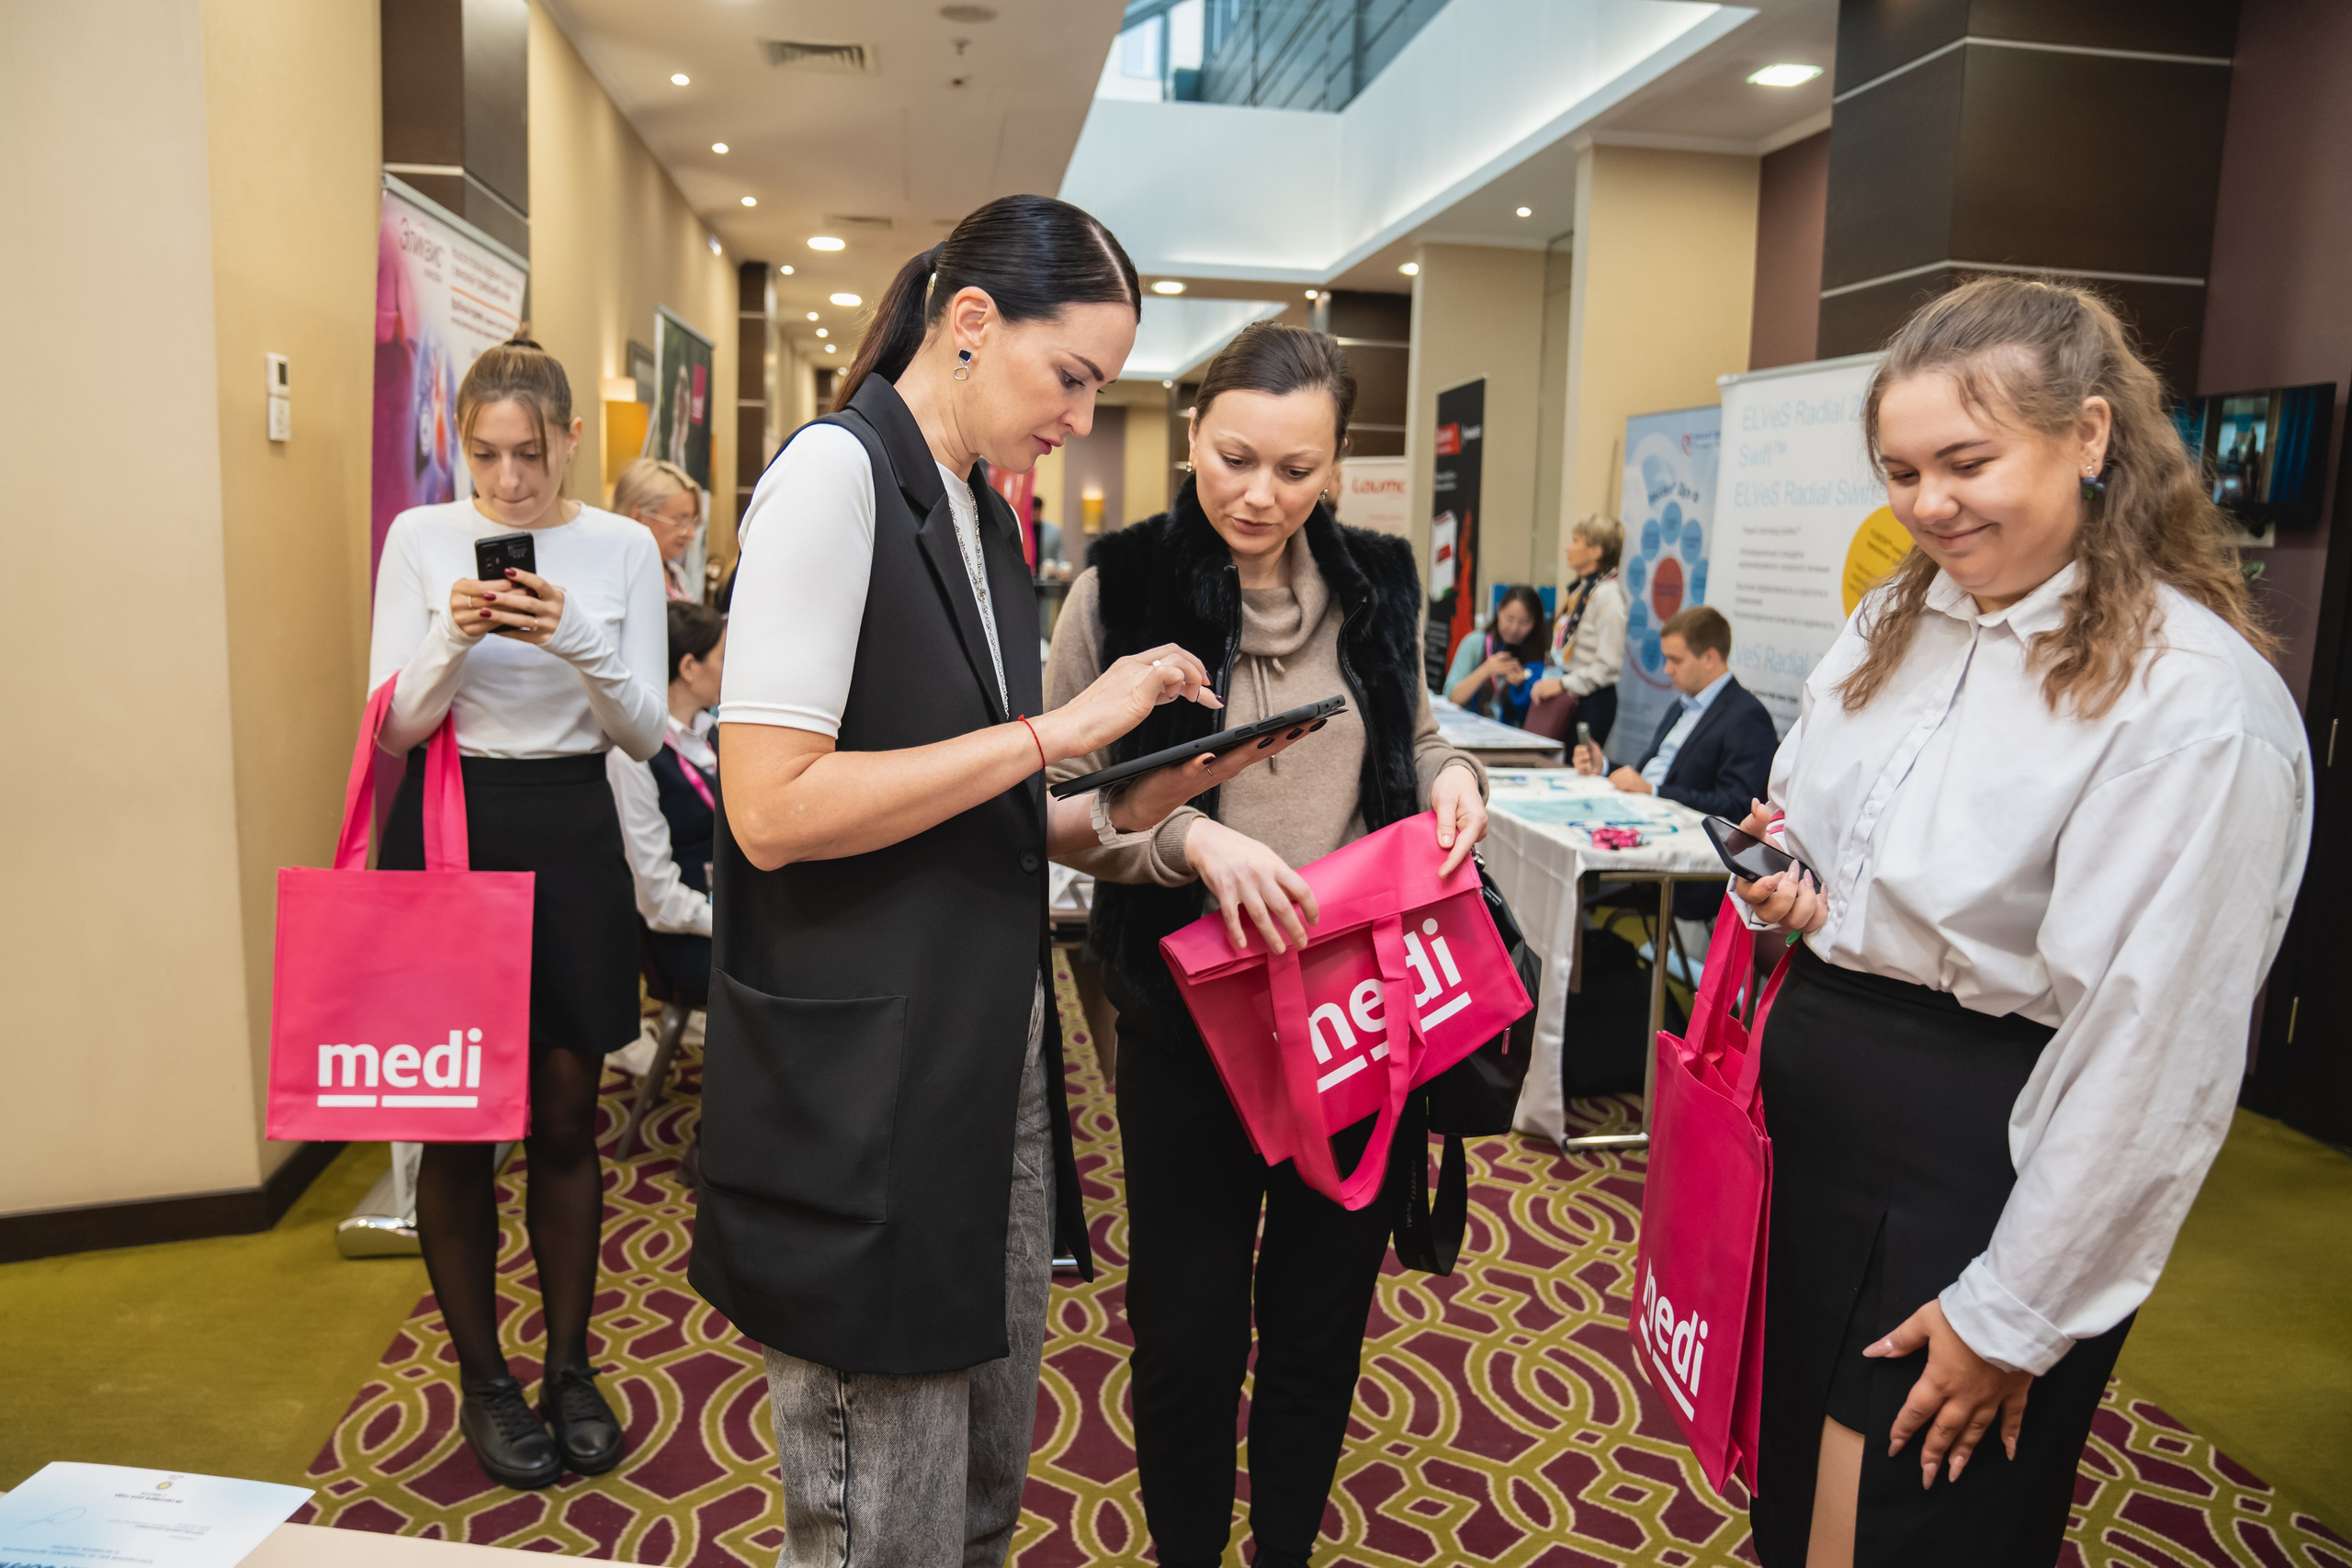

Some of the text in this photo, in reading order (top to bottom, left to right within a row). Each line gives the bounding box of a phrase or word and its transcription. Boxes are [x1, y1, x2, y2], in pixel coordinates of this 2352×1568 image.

[1794, 395, 1845, 425] Radial
[1784, 479, 1831, 506] Radial
[318, 1027, 483, 1089] medi
